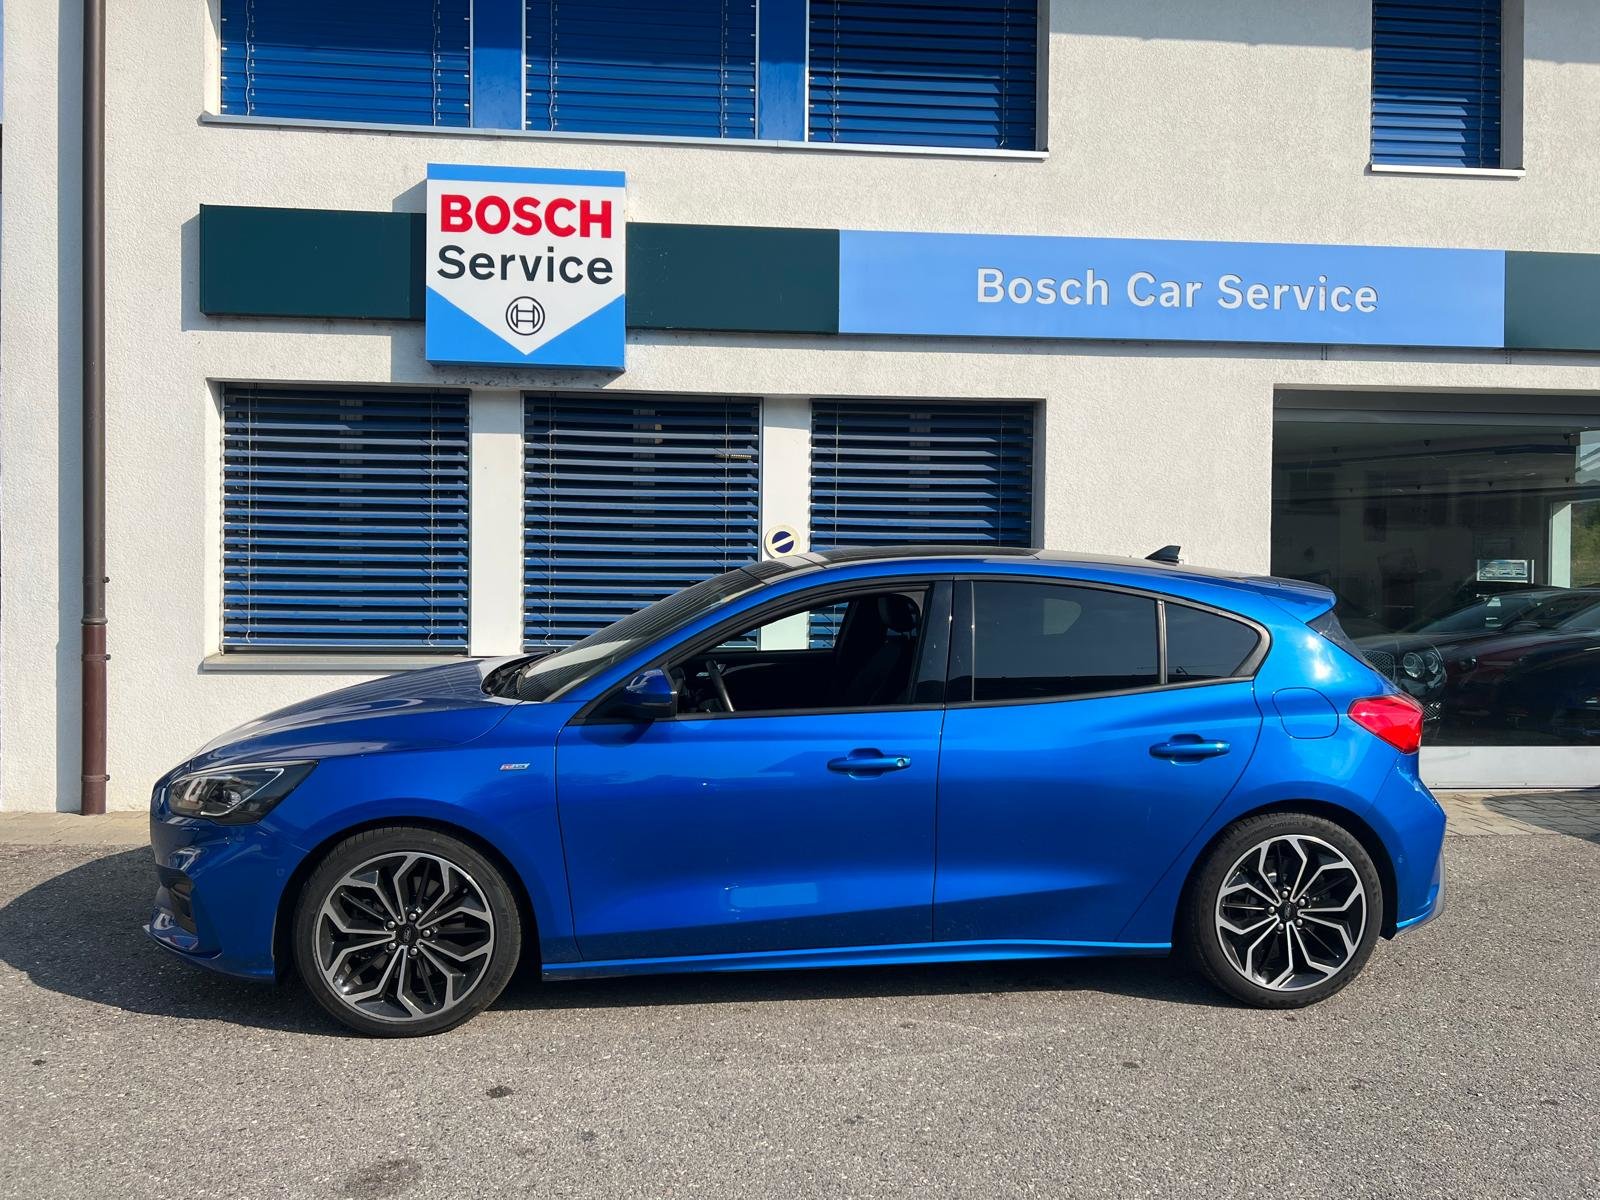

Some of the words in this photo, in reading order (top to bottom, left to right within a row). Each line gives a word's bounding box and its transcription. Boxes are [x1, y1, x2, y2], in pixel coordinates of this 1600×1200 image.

[440, 194, 612, 239] BOSCH
[437, 244, 613, 285] Service
[976, 267, 1110, 306] Bosch
[1126, 271, 1203, 308] Car
[1217, 273, 1379, 313] Service
